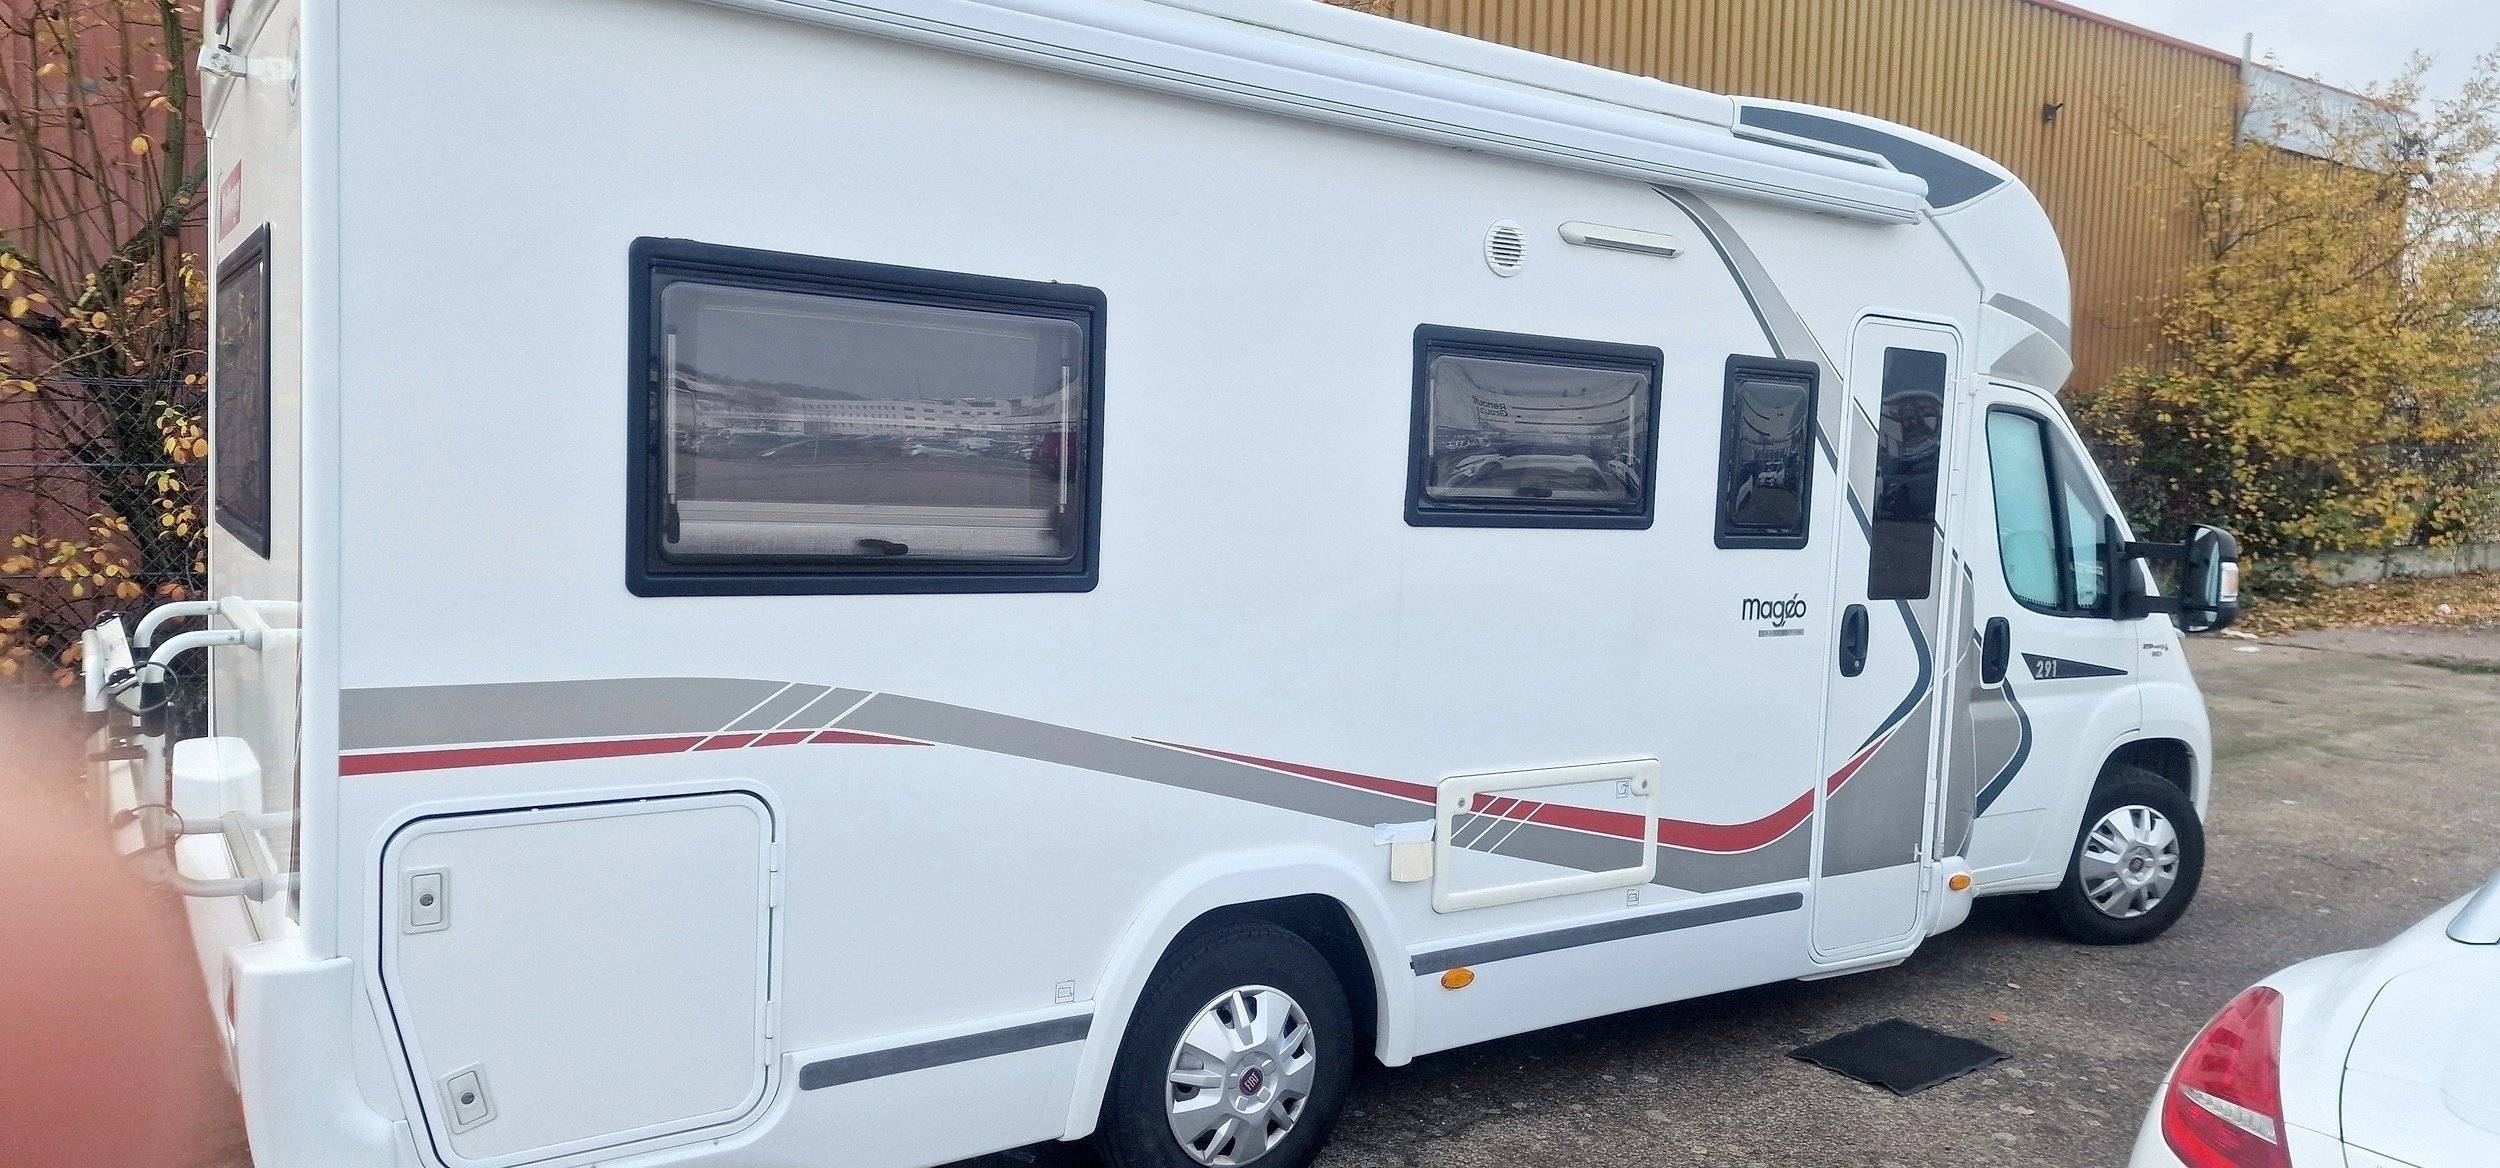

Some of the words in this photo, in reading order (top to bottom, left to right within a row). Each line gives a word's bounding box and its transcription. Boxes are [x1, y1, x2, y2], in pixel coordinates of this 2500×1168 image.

[1741, 592, 1807, 628] magéo
[2036, 660, 2057, 678] 291
[1244, 1071, 1260, 1091] FIAT
